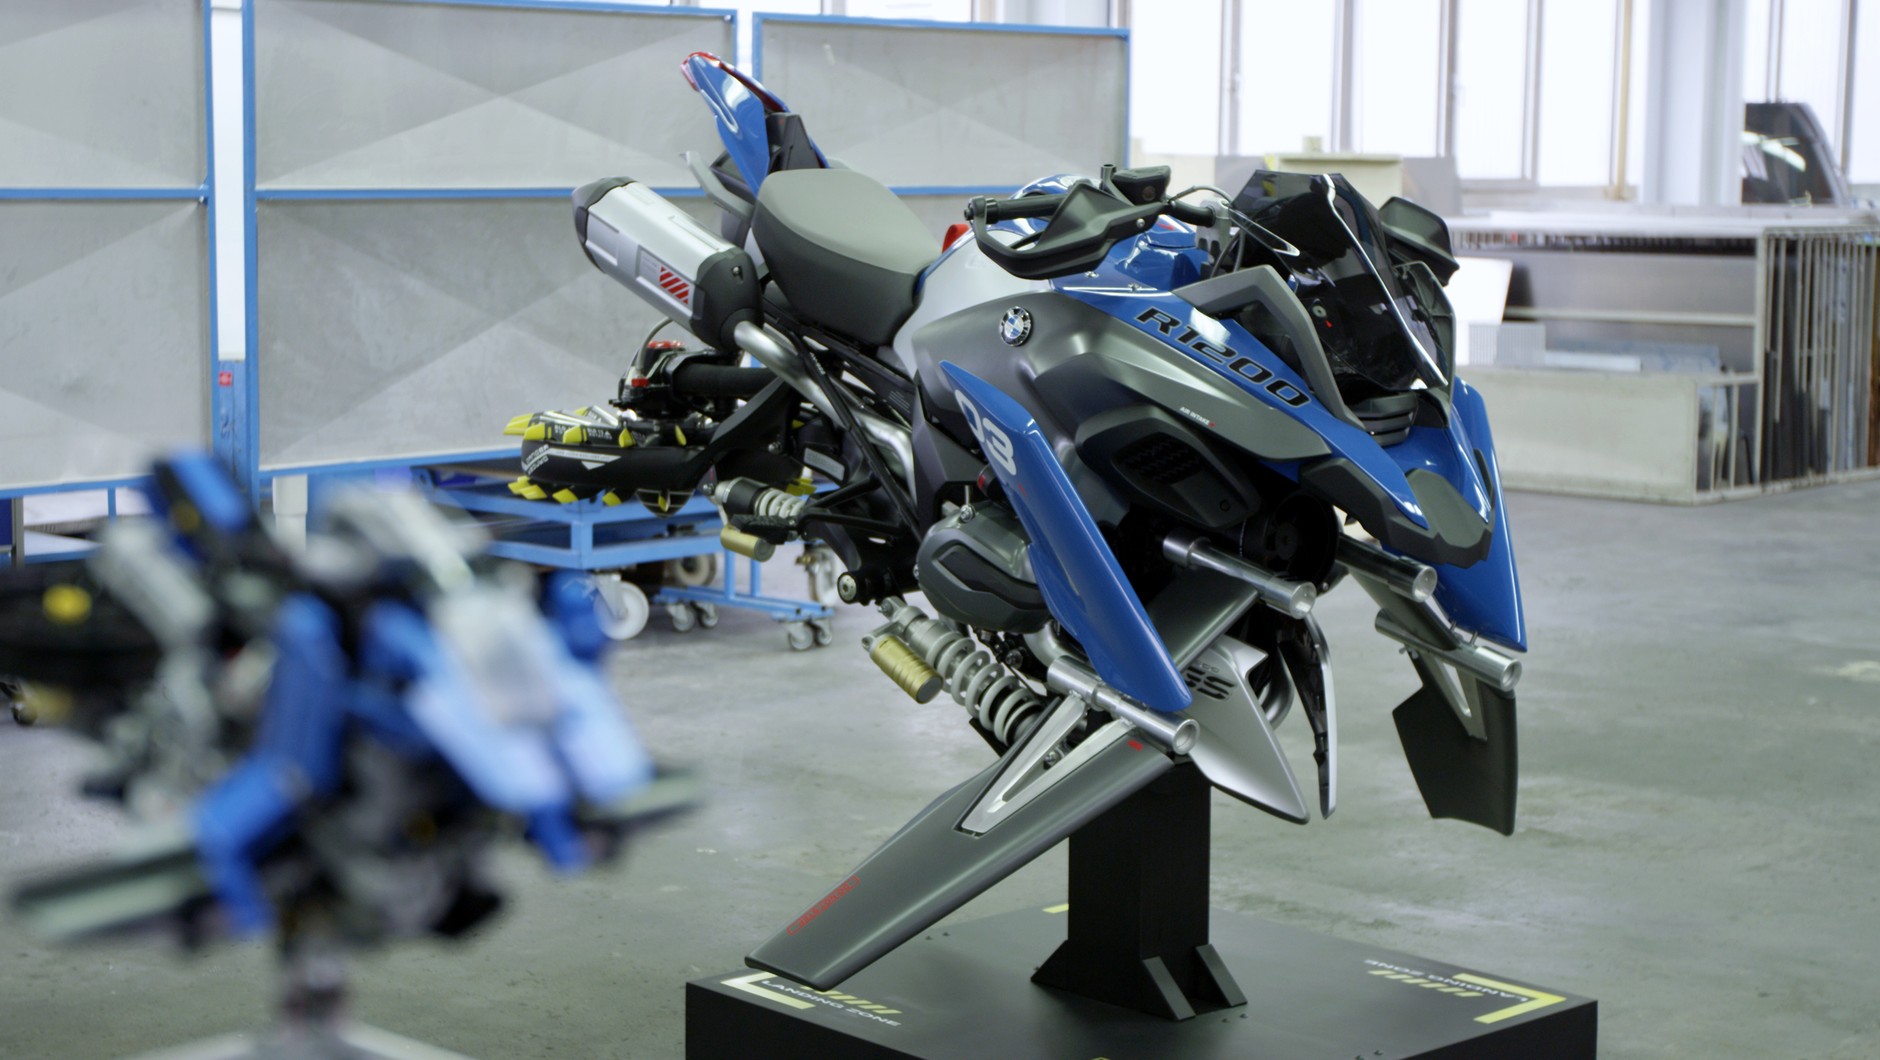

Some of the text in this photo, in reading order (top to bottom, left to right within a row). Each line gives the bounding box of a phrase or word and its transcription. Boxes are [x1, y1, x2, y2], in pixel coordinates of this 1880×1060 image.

[1135, 306, 1312, 408] R1200
[954, 389, 1017, 476] 03
[761, 980, 902, 1027] LANDING ZONE
